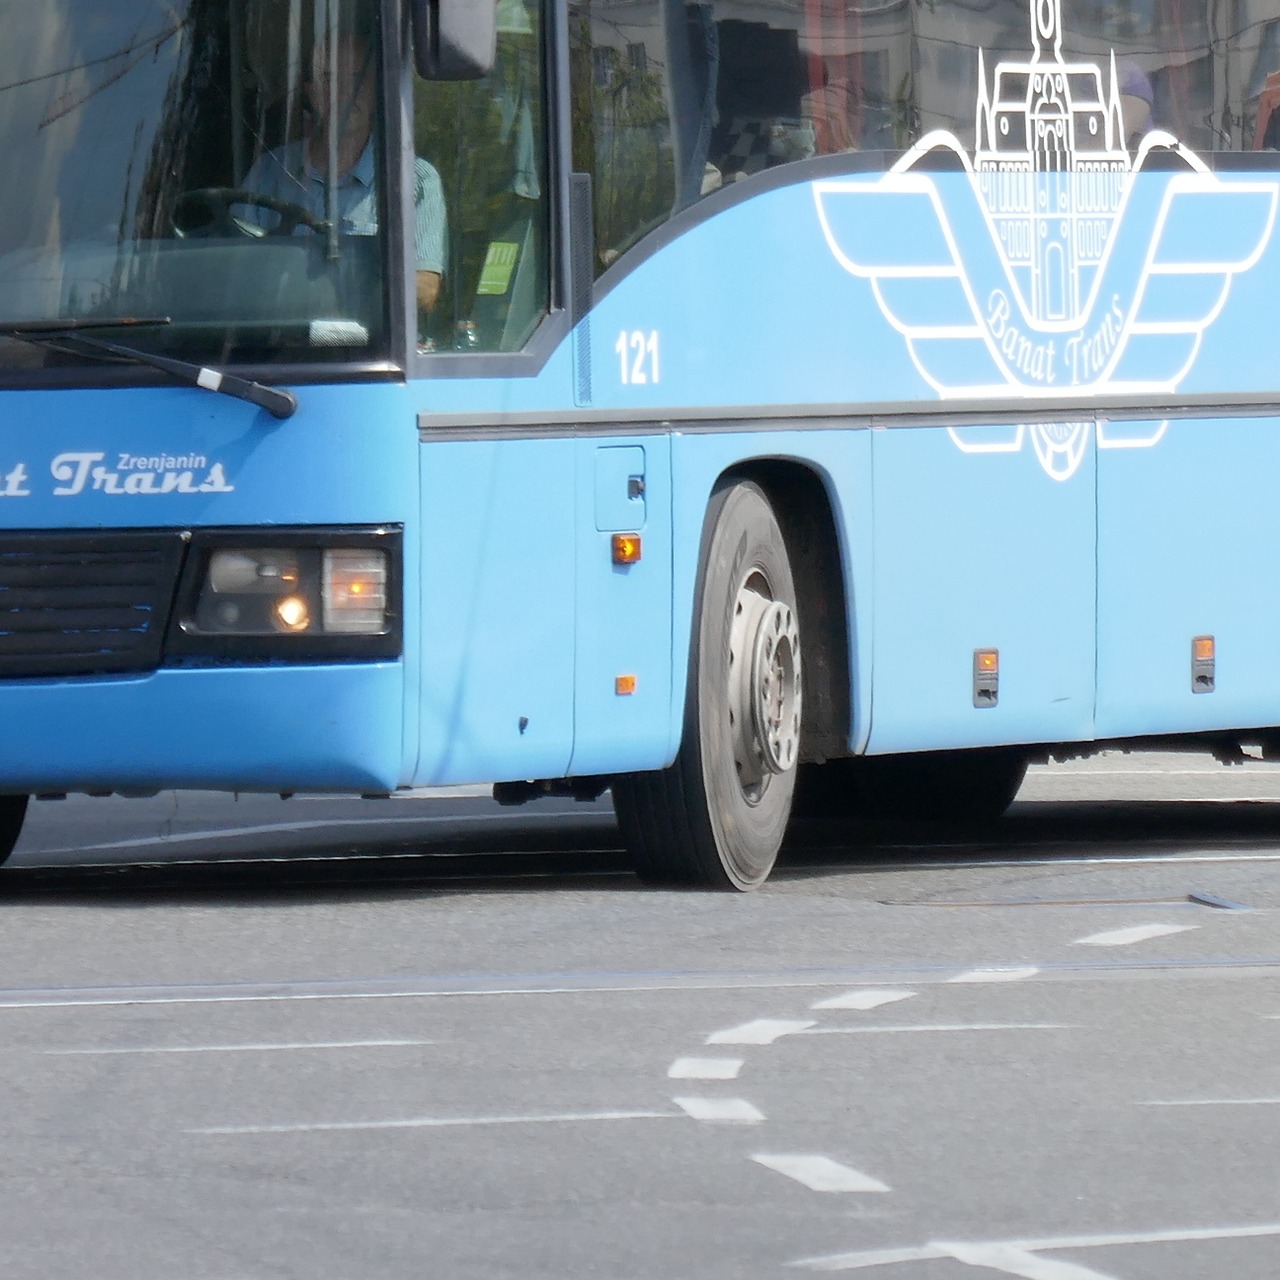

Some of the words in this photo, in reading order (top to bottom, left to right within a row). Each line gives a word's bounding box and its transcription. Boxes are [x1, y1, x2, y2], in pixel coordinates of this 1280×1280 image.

[615, 330, 659, 384] 121
[986, 288, 1056, 384] Banat
[1064, 294, 1123, 386] Trans
[50, 452, 235, 495] Trans
[118, 453, 206, 472] Zrenjanin
